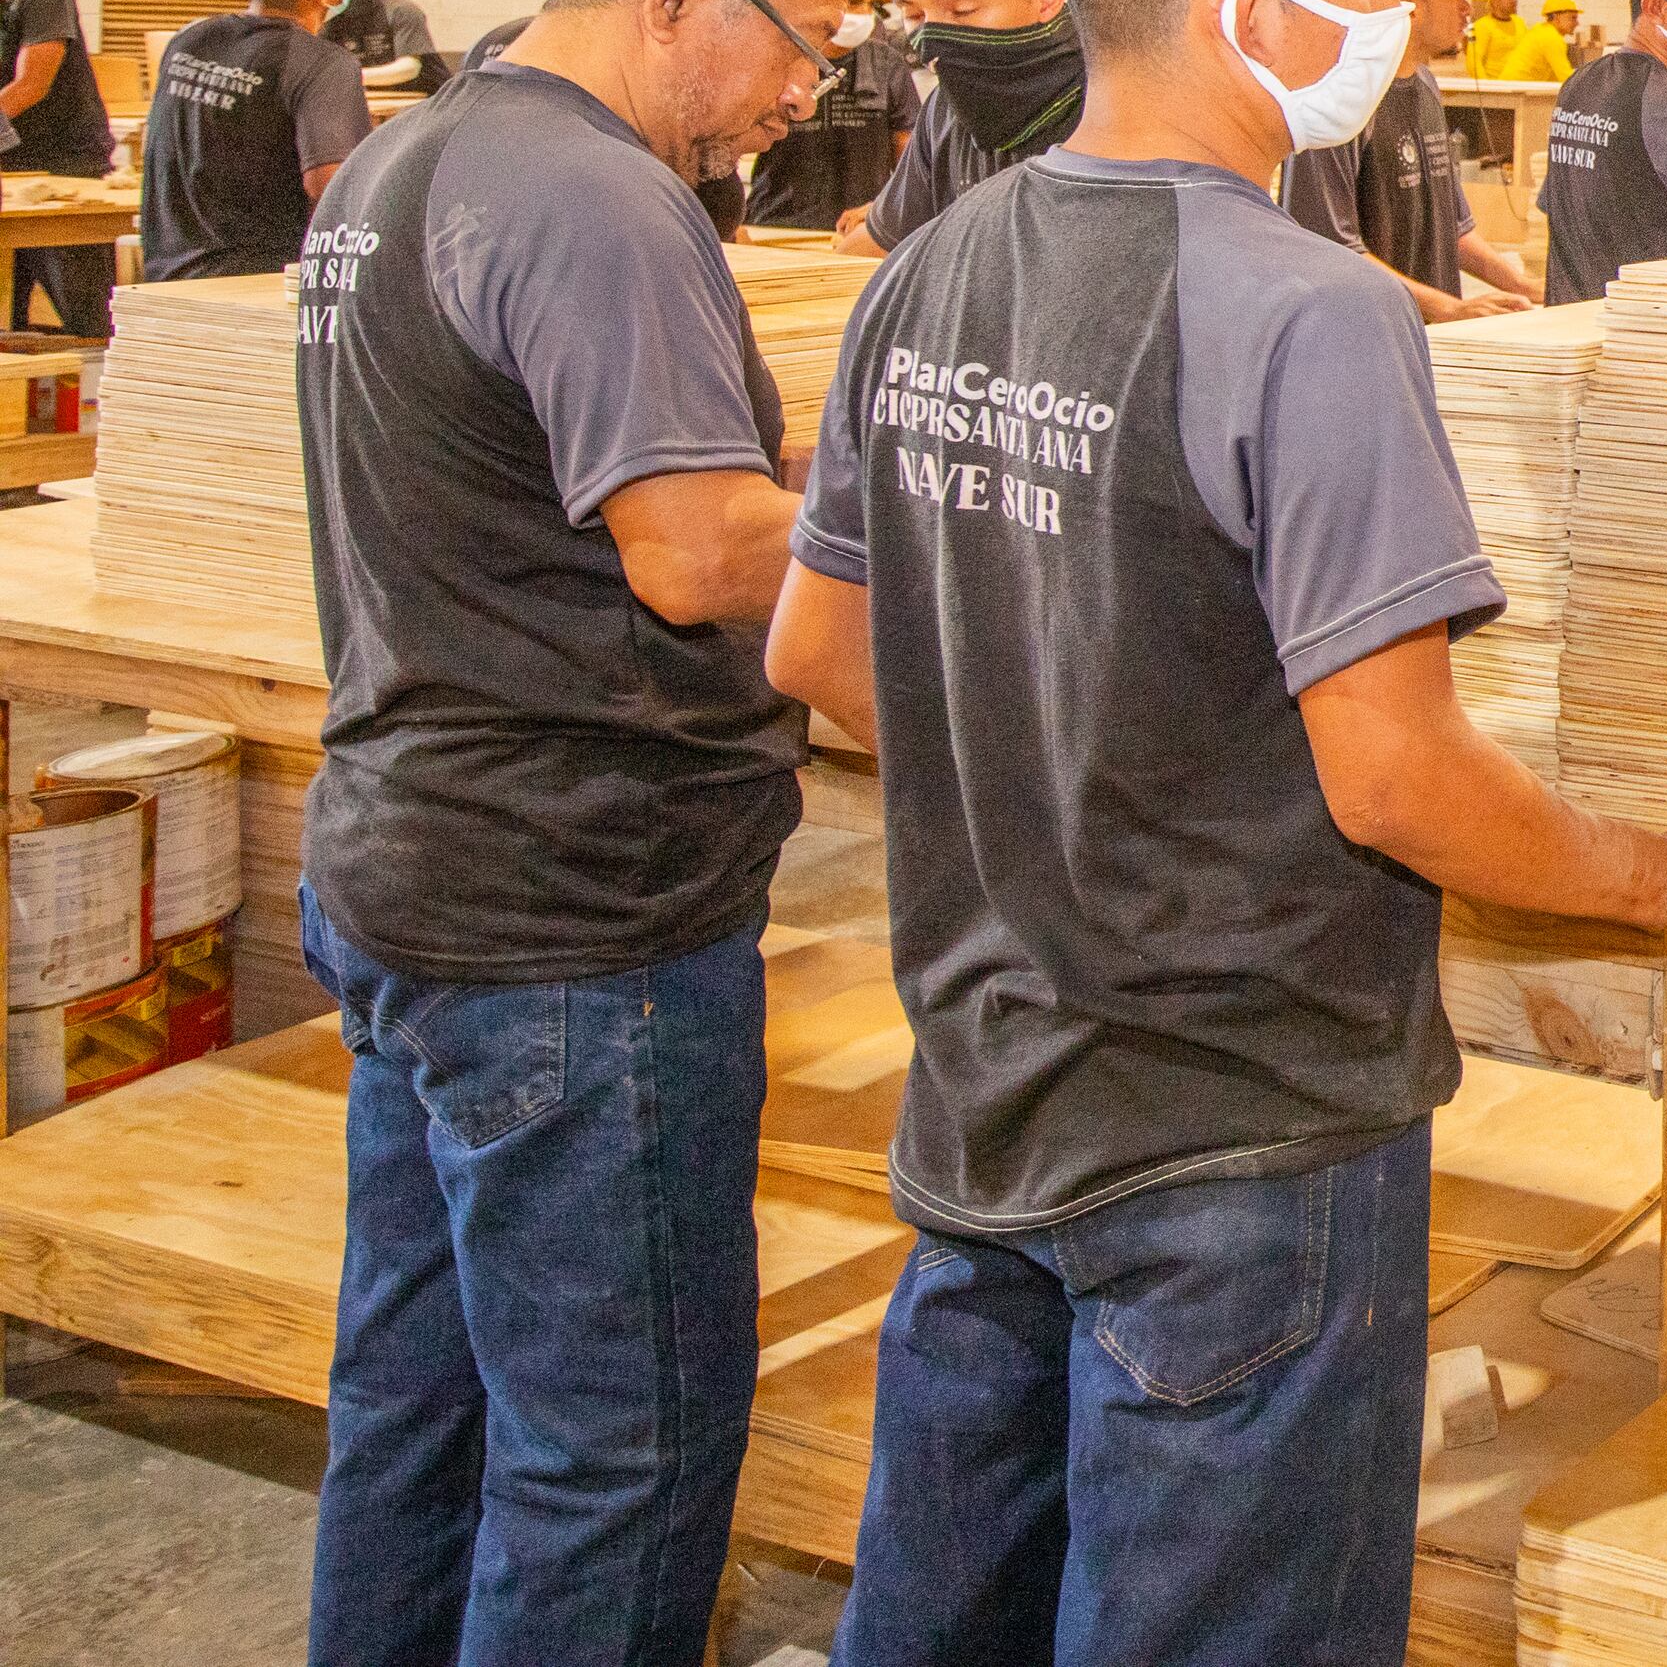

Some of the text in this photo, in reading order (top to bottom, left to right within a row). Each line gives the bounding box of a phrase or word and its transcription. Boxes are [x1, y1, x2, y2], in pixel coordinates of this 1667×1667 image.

[873, 387, 1093, 475] CICPR SANTA ANA
[896, 446, 1063, 535] NAVE SUR
